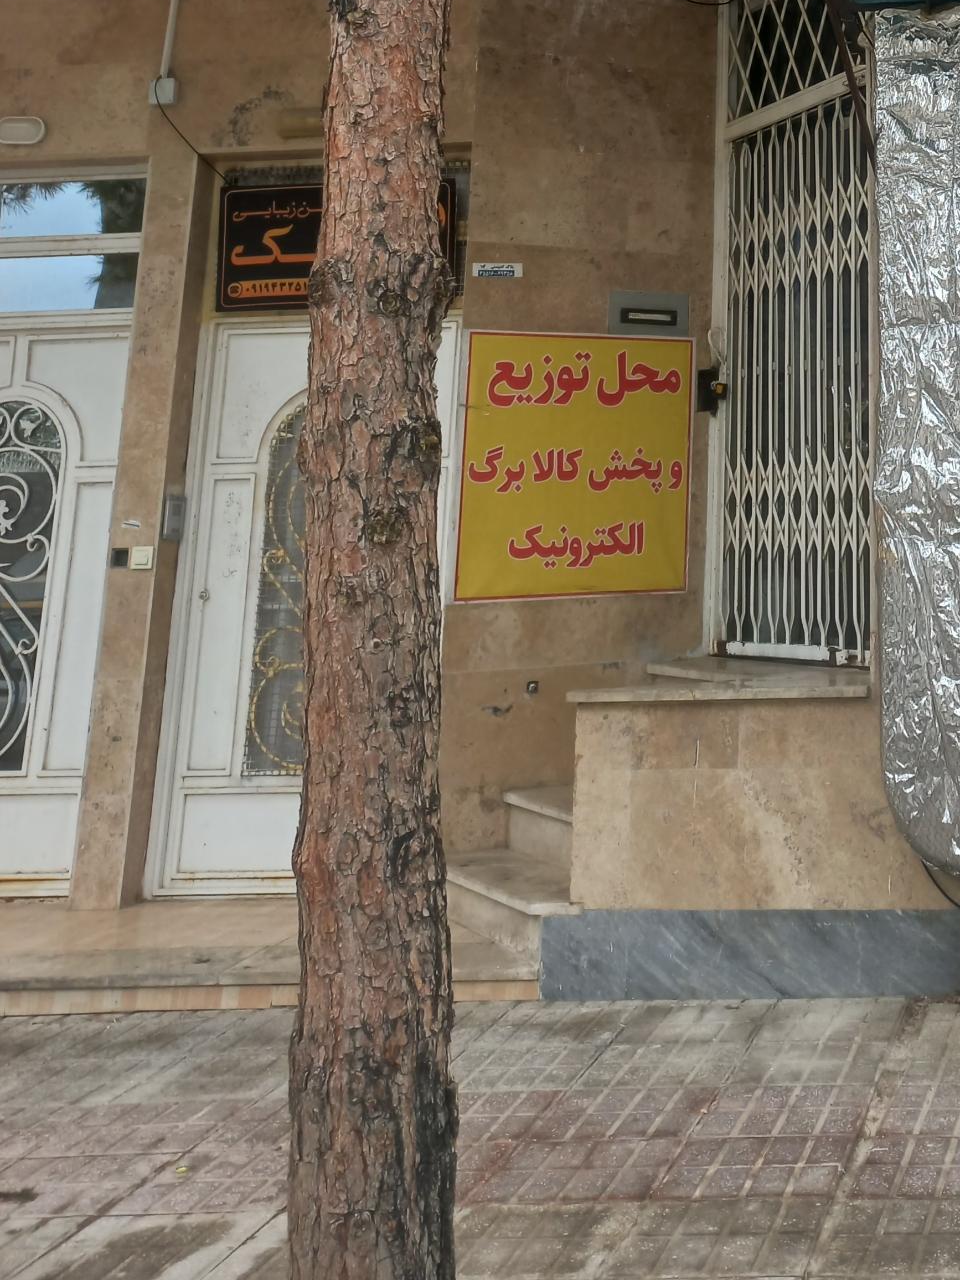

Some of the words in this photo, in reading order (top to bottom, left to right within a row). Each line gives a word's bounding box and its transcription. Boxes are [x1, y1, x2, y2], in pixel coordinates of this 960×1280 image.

[232, 200, 297, 222] زیبایی
[487, 351, 592, 407] توزیع
[597, 351, 681, 407] محل
[468, 446, 526, 494] برگ
[532, 448, 583, 483] کالا
[587, 447, 664, 494] پخش
[667, 459, 683, 490] و
[508, 521, 645, 569] الکترونیک
